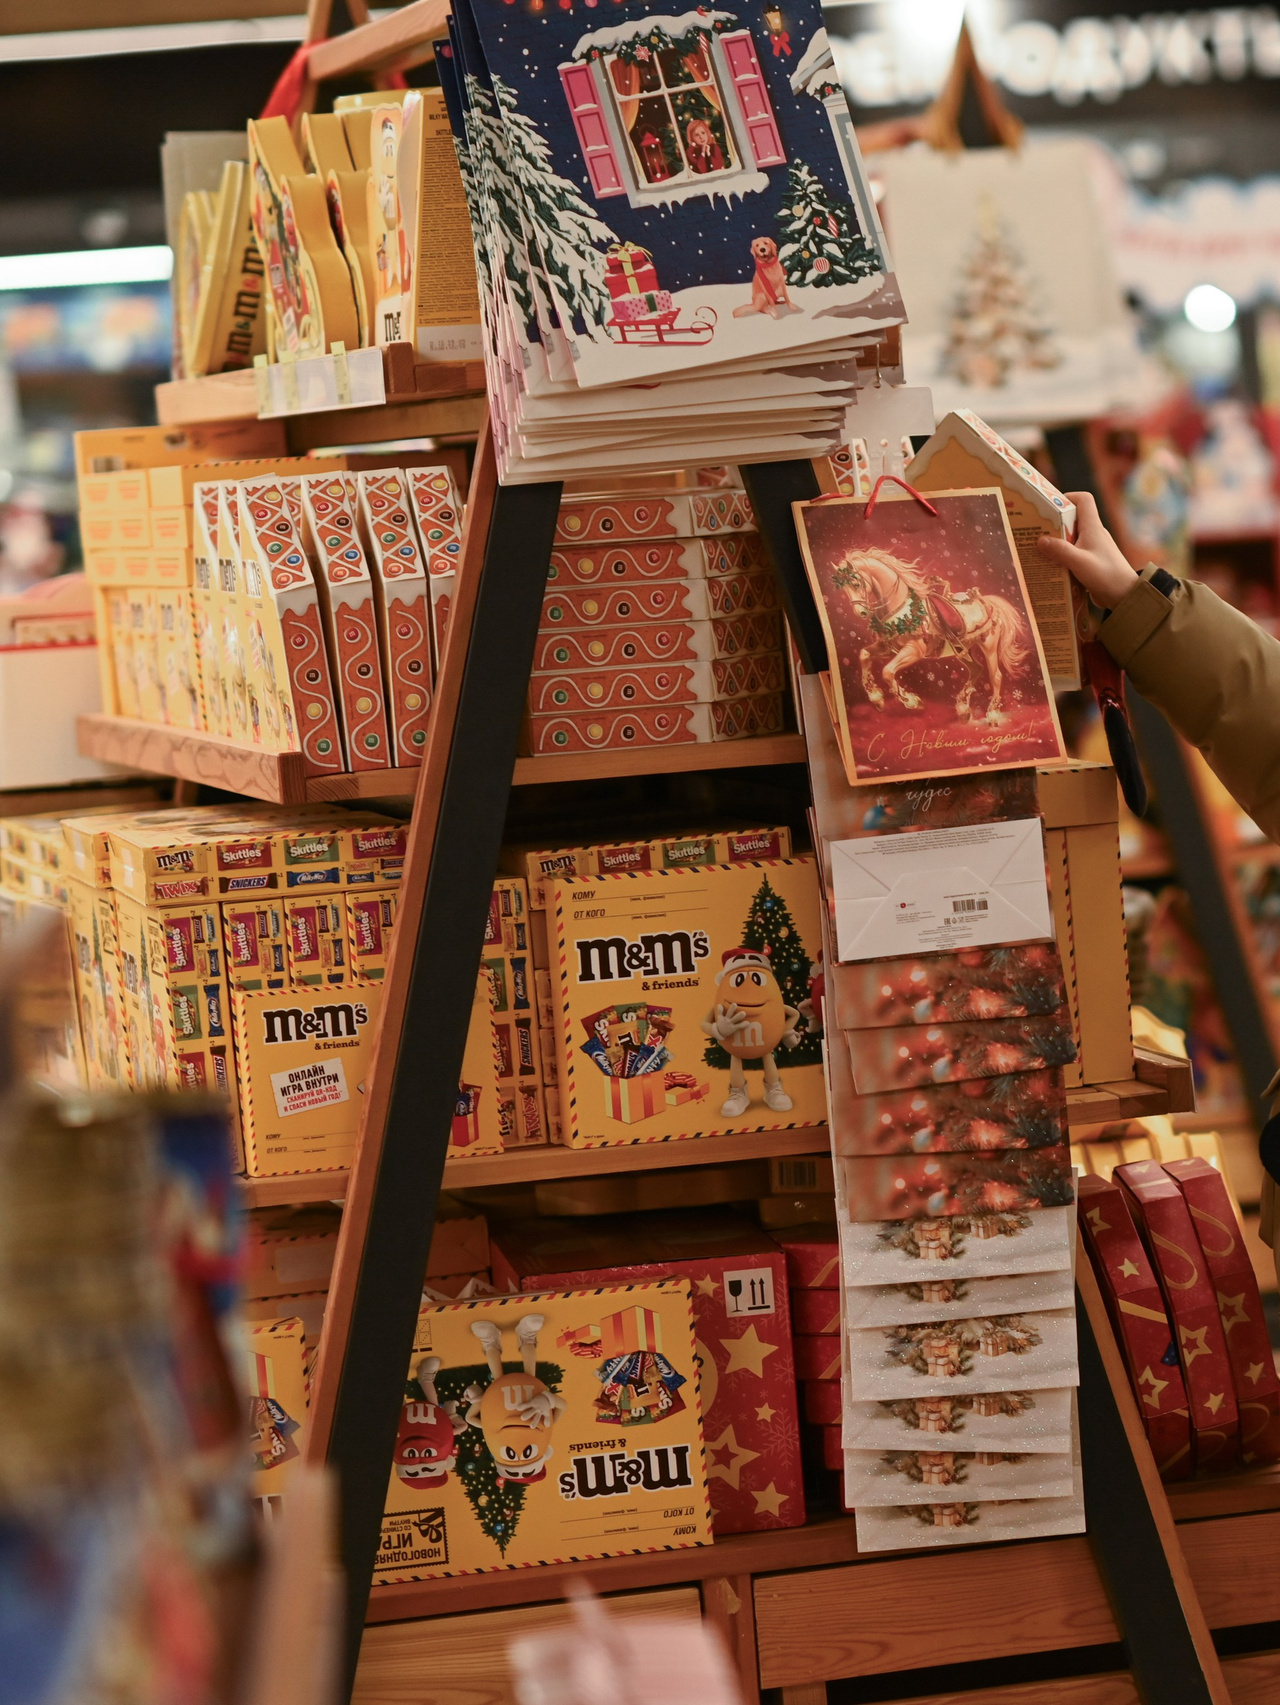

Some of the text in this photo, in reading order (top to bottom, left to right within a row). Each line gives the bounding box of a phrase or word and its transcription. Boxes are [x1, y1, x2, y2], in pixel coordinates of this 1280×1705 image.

[867, 733, 885, 762] С
[290, 843, 329, 857] Skittles
[358, 837, 396, 852] Skittles
[733, 840, 770, 854] Skittles
[222, 848, 261, 863] Skittles
[604, 853, 641, 867] Skittles
[668, 846, 705, 860] Skittles
[229, 877, 267, 889] SNICKERS
[572, 890, 596, 900] КОМУ
[574, 911, 584, 919] ОТ
[585, 909, 605, 918] КОГО
[297, 917, 311, 956] Skittles
[361, 911, 374, 950] Skittles
[172, 927, 187, 967] Skittles
[238, 922, 251, 961] Skittles
[652, 978, 699, 990] friends
[180, 996, 194, 1035] Skittles
[323, 1040, 360, 1050] friends
[519, 1029, 532, 1066] SNICKERS
[288, 1064, 325, 1083] ОНЛАЙН
[280, 1073, 339, 1097] ИГРА ВНУТРИ
[569, 1439, 616, 1452] friends
[663, 1507, 695, 1518] ОТ КОГО
[381, 1525, 403, 1534] СТИКЕР
[673, 1526, 697, 1536] КОМУ
[379, 1533, 413, 1550] ИГР
